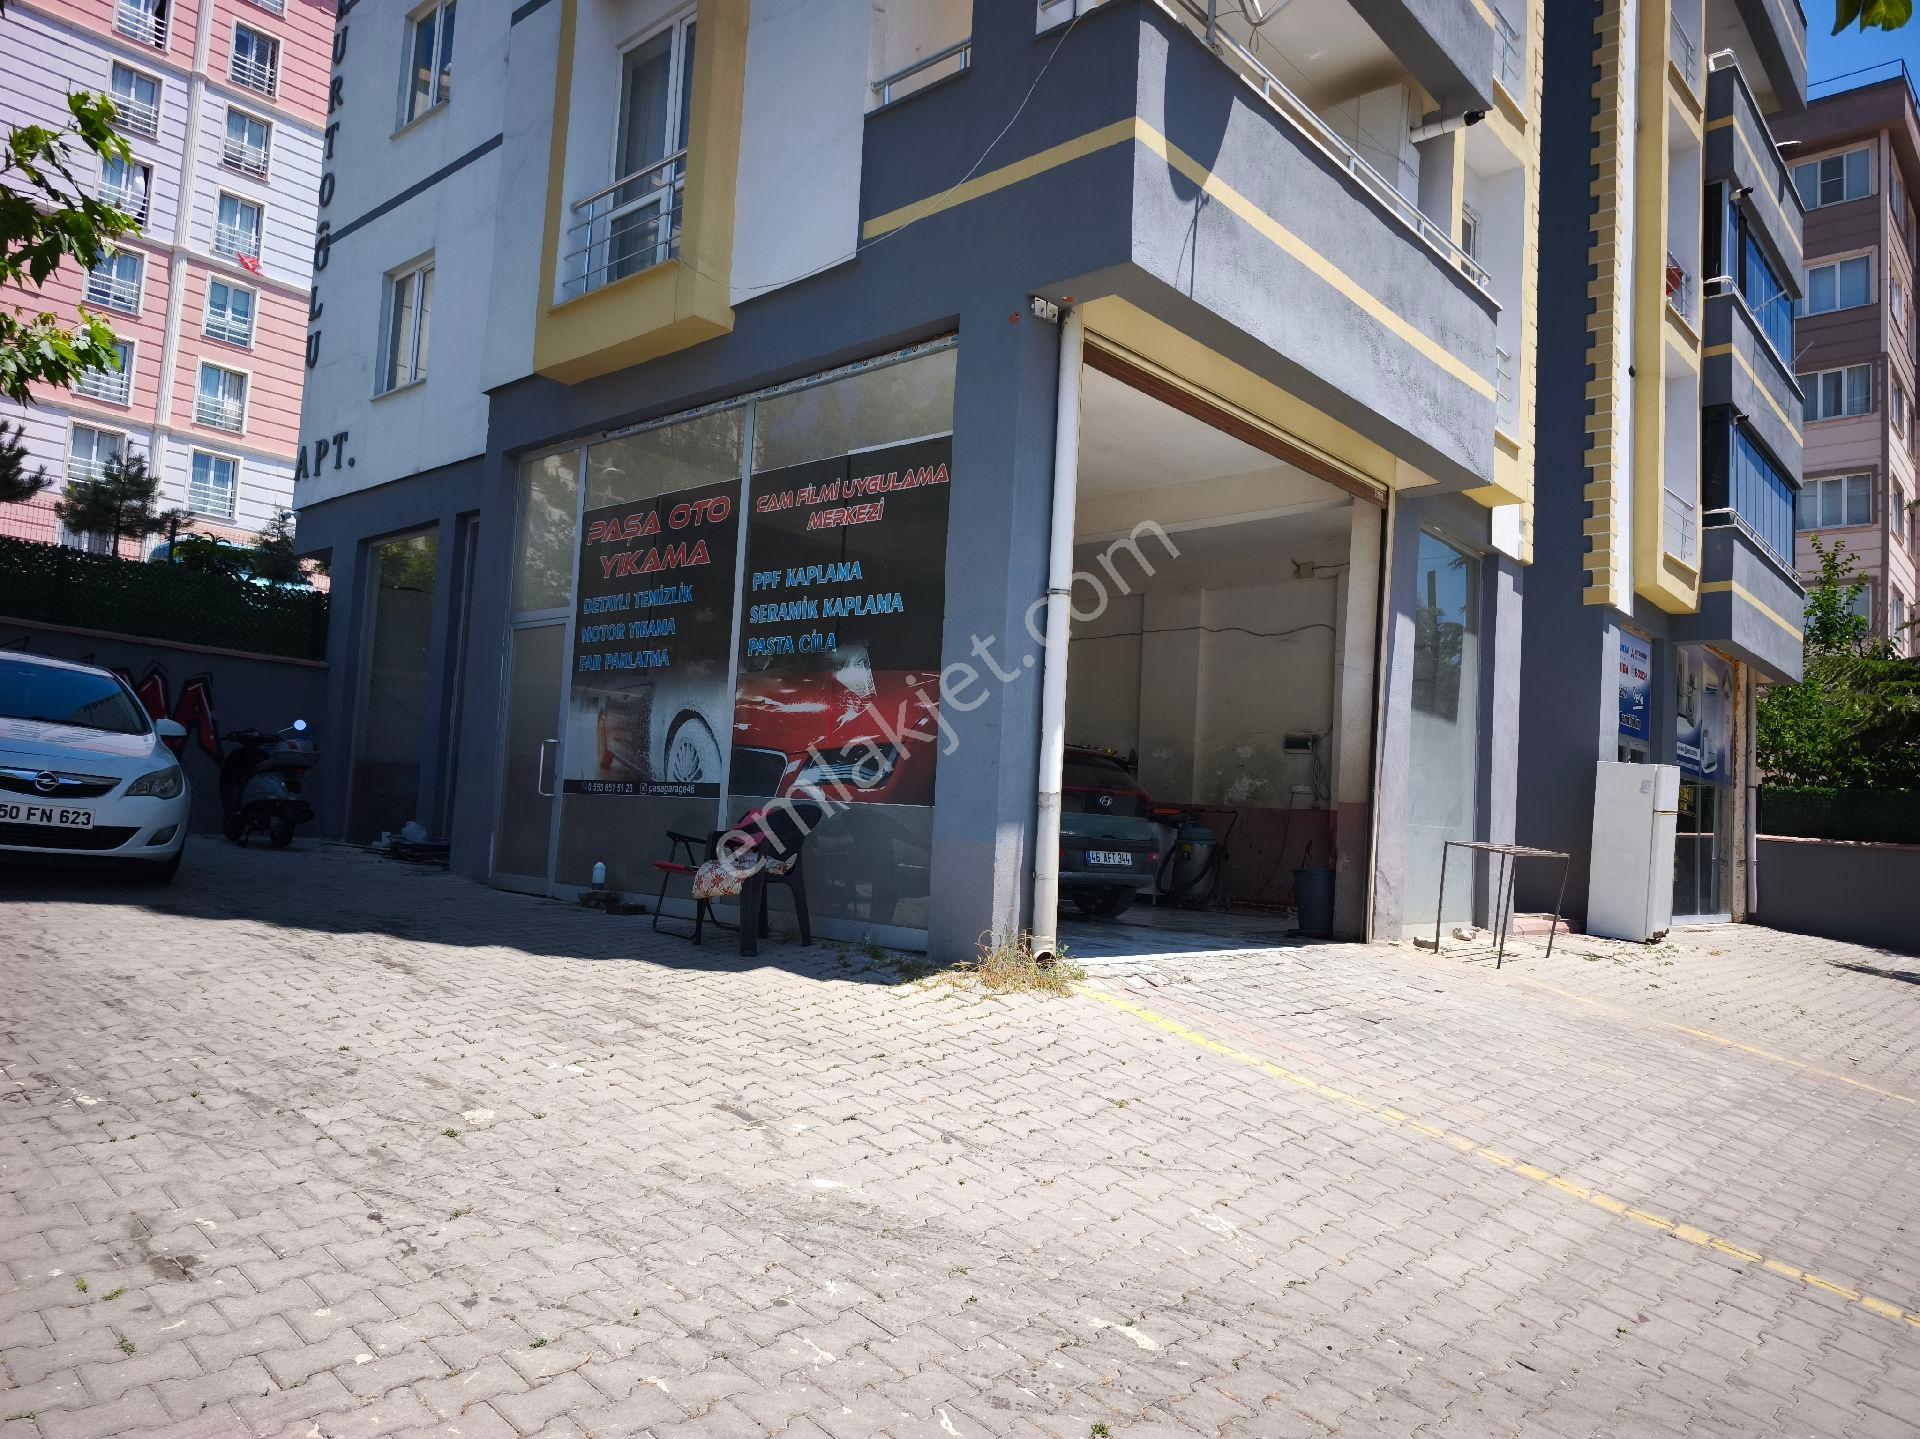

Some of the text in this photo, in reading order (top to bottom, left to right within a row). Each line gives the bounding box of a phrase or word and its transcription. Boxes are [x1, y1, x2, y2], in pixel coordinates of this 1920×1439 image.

[294, 431, 356, 481] APT.
[756, 463, 950, 513] CAM FİLMİ UYGULAMA
[586, 495, 731, 546] PAŞA OTO
[806, 496, 885, 531] MERKEZİ
[600, 539, 711, 579] YIKAMA
[752, 560, 863, 592] PPF KAPLAMA
[583, 582, 694, 615] DETAYLI TEMİZLİK
[749, 592, 905, 624] SERAMİK KAPLAMA
[581, 617, 677, 643] MOTOR YIKAMA
[747, 628, 837, 657] PASTA CİLA
[579, 648, 670, 672] FAR PARLATMA
[0, 803, 92, 826] 50 FN 623
[1091, 851, 1131, 865] 46 AFT 344
